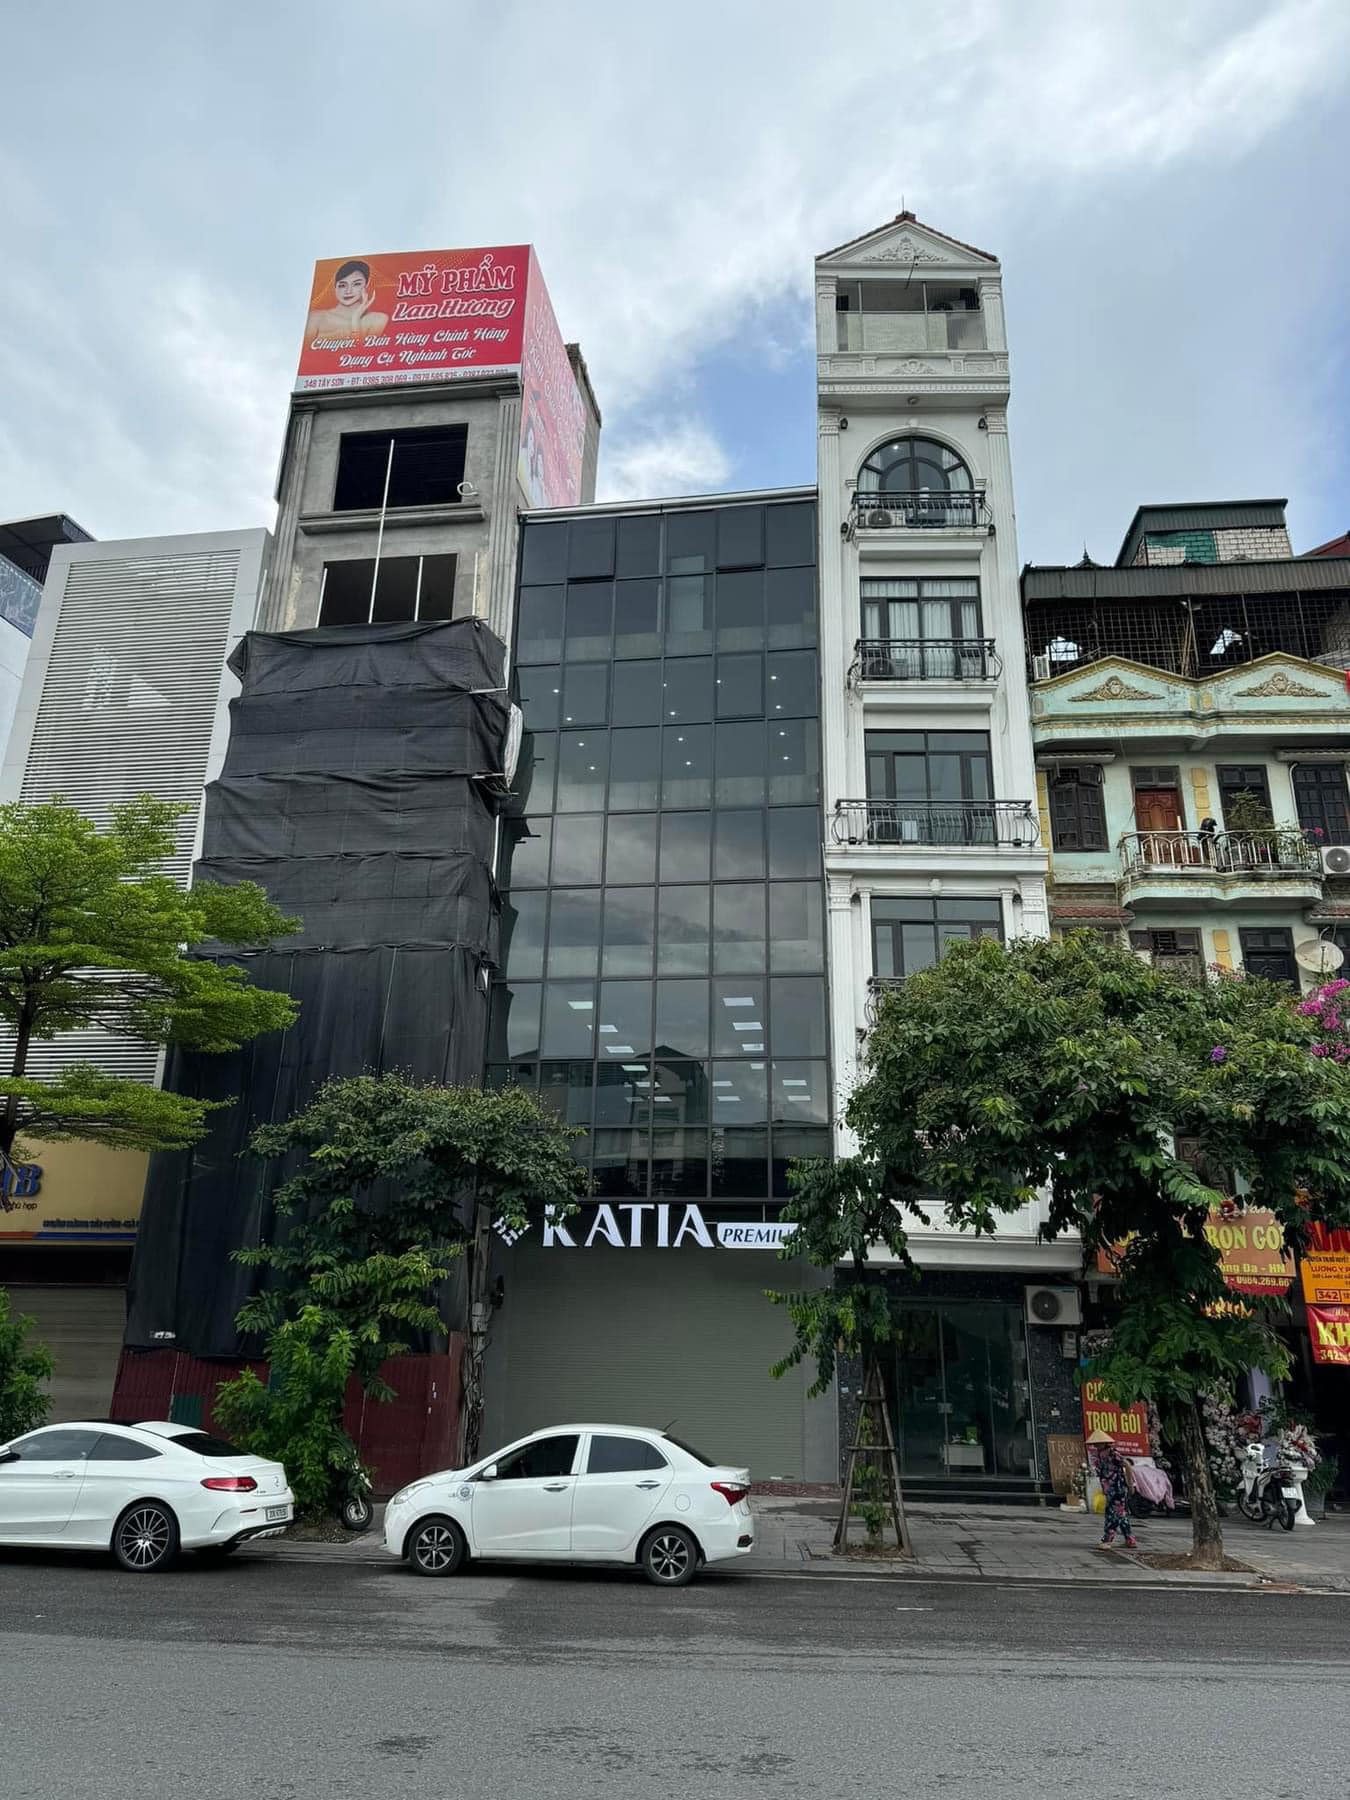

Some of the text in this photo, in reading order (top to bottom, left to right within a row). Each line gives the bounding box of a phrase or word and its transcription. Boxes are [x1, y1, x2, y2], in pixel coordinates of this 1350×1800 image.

[397, 254, 515, 297] MỸ PHẨM
[392, 298, 515, 321] Lan Hương
[542, 1203, 796, 1248] KATIA PREMIU
[1202, 1225, 1248, 1256] RỌN
[1318, 1290, 1339, 1300] 342
